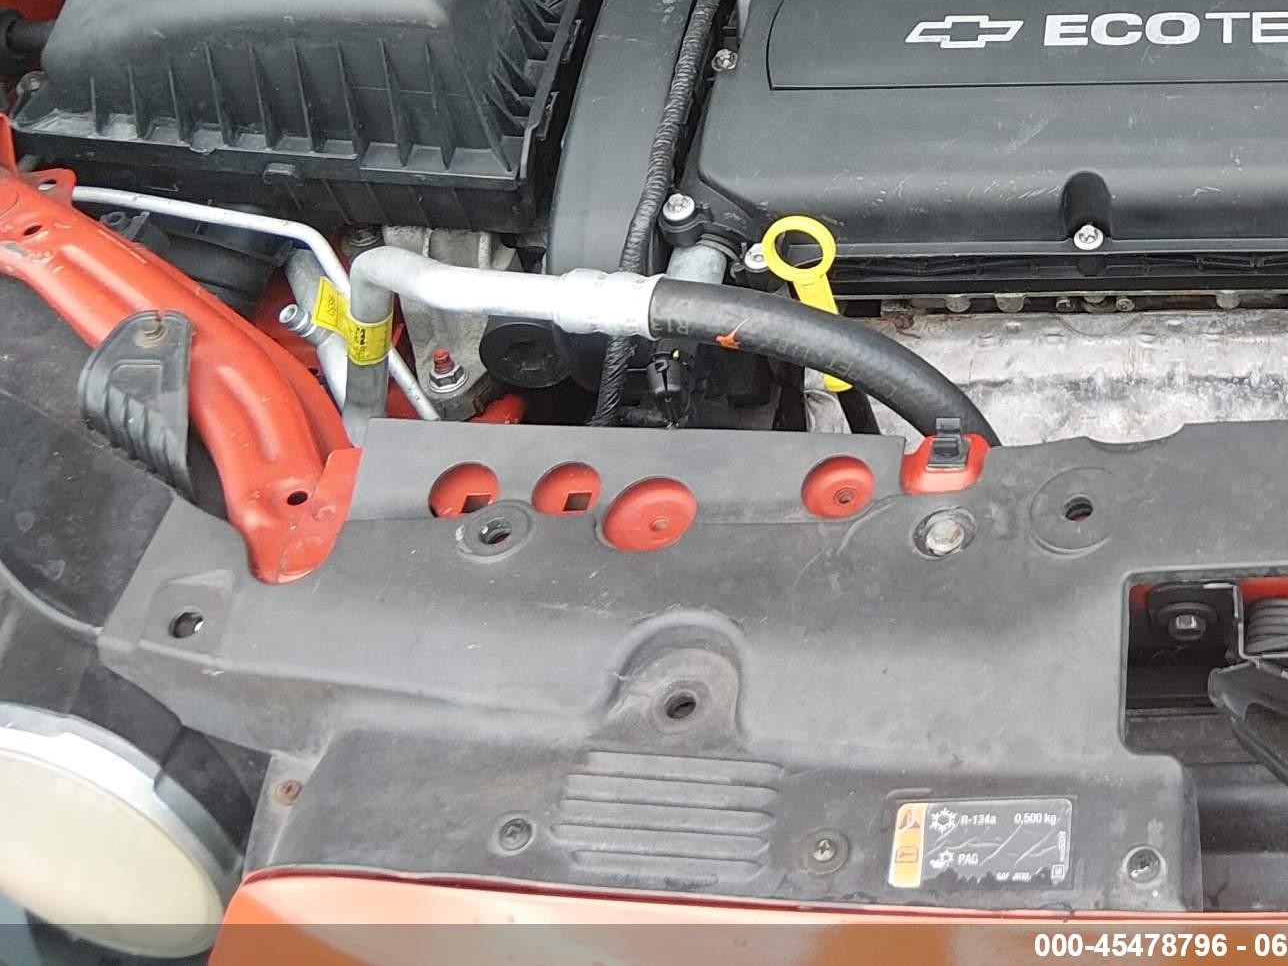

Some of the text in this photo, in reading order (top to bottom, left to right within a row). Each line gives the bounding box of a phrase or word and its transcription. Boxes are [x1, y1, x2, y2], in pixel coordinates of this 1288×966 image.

[960, 814, 997, 825] R-134a
[1044, 813, 1057, 825] kg
[958, 853, 979, 865] PAG
